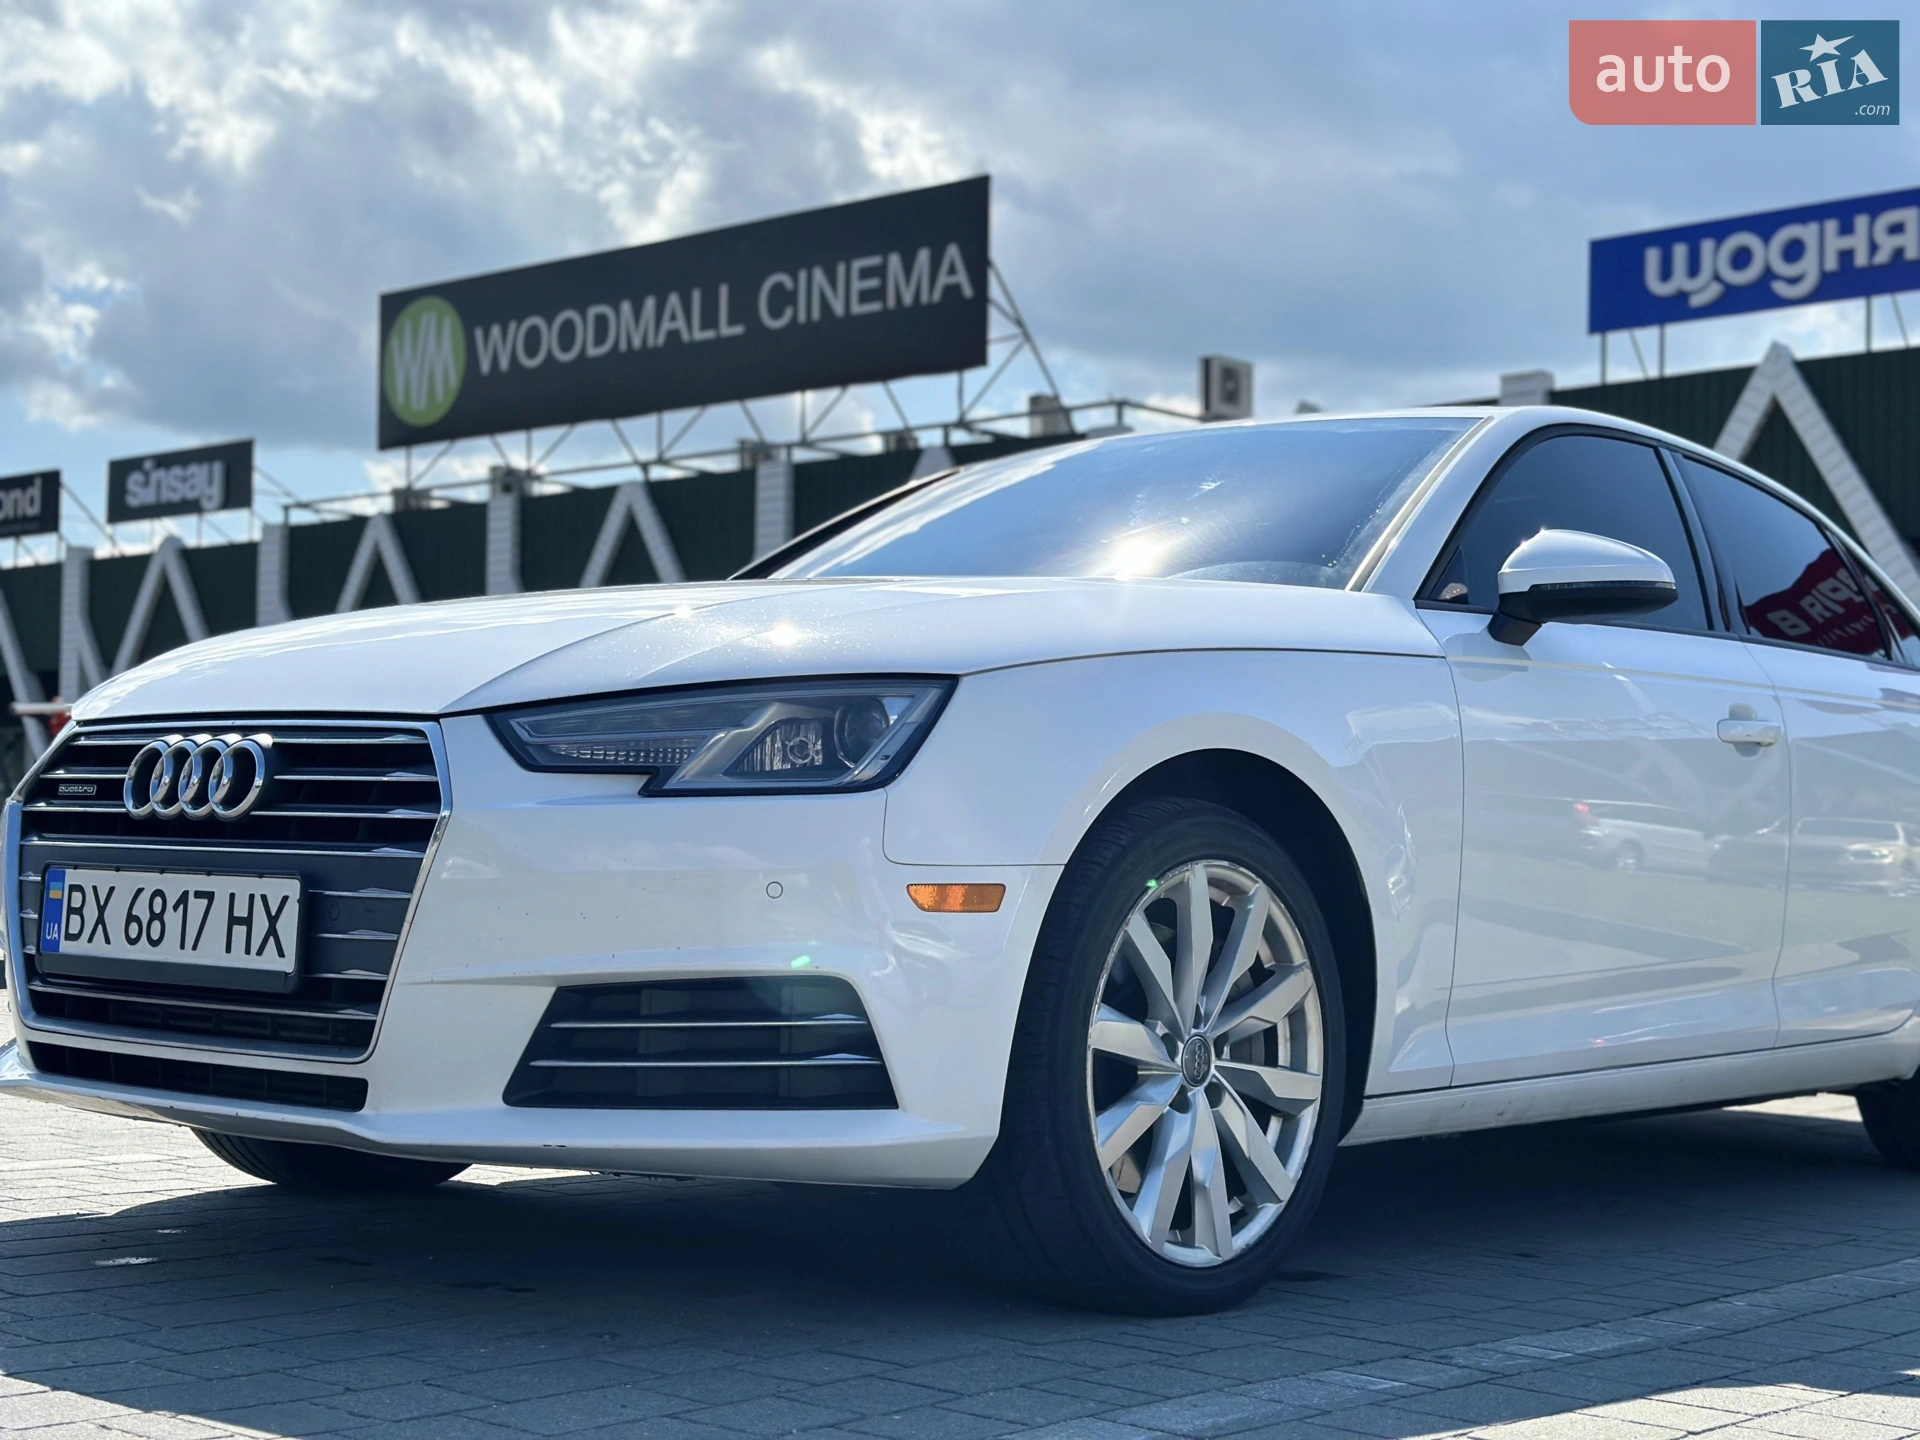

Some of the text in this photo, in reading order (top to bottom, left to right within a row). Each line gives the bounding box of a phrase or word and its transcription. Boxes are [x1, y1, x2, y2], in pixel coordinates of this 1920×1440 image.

[474, 242, 974, 376] WOODMALL CINEMA
[125, 459, 225, 509] sinsay
[59, 786, 94, 794] quattro
[46, 923, 59, 941] UA
[64, 883, 290, 959] BX 6817 HX
